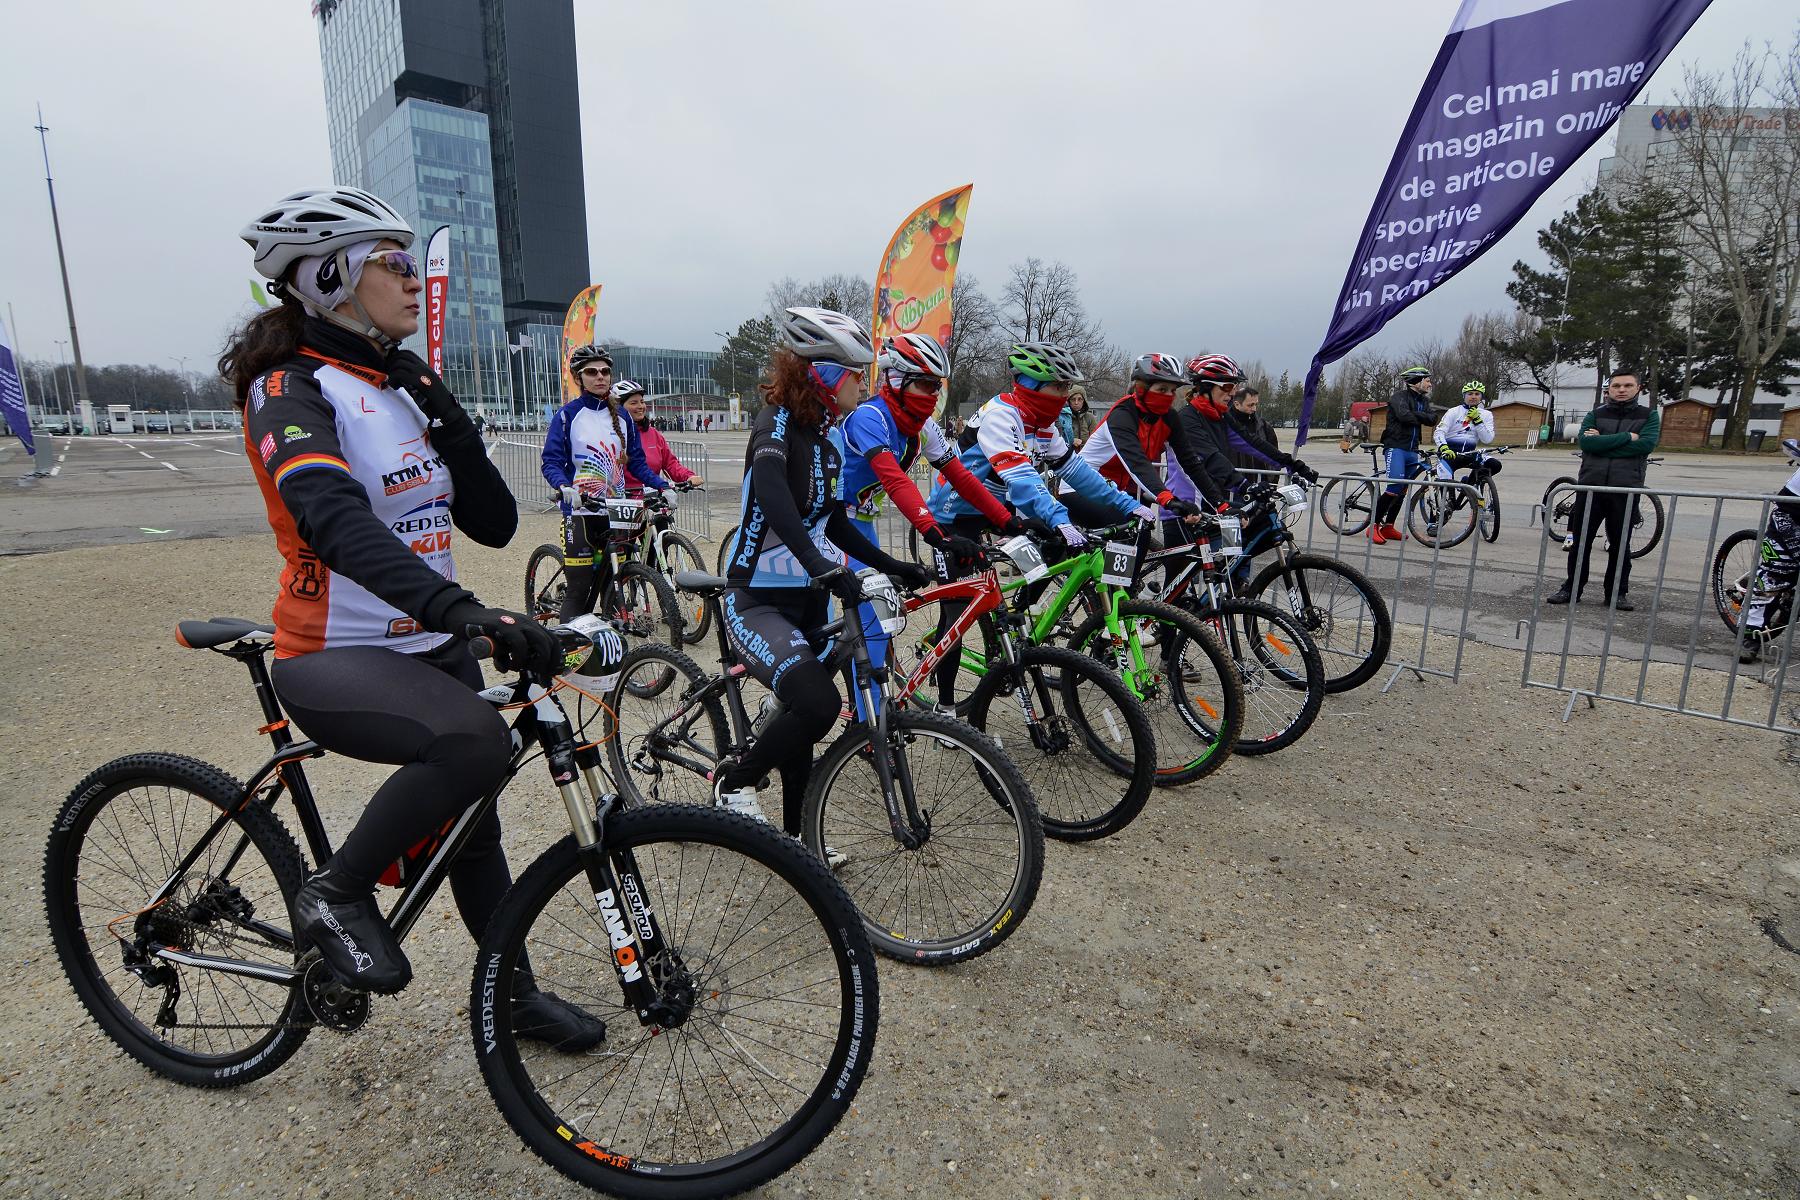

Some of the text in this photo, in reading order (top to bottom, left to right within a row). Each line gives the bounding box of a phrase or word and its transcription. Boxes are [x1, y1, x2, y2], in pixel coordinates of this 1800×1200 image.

[1442, 60, 1645, 118] Cel mai mare
[1417, 101, 1626, 163] magazin onlin
[1742, 114, 1782, 130] Trade
[1400, 152, 1556, 202] de articole
[256, 225, 309, 234] LONGUS
[1375, 203, 1482, 242] sportive
[432, 281, 442, 341] CLUB
[432, 346, 442, 380] RS
[267, 370, 286, 397] KTM
[382, 464, 422, 487] KTM
[813, 444, 824, 478] Bike
[615, 506, 638, 519] 107
[736, 505, 765, 569] Perfect
[1113, 553, 1128, 573] 83
[726, 592, 776, 667] Perfect Bike
[598, 630, 624, 667] 109
[778, 654, 802, 671] Bike
[1178, 703, 1211, 738] MERIDA
[58, 780, 107, 833] VREDESTEIN
[317, 898, 364, 968] ENDURA
[629, 892, 654, 940] SUNTOUR
[952, 938, 981, 956] GATO
[851, 964, 863, 995] XTREME
[485, 952, 502, 1056] VREDESTEIN
[853, 995, 864, 1038] PANTHER
[243, 1051, 263, 1071] BLACK
[845, 1037, 861, 1070] BLACK
